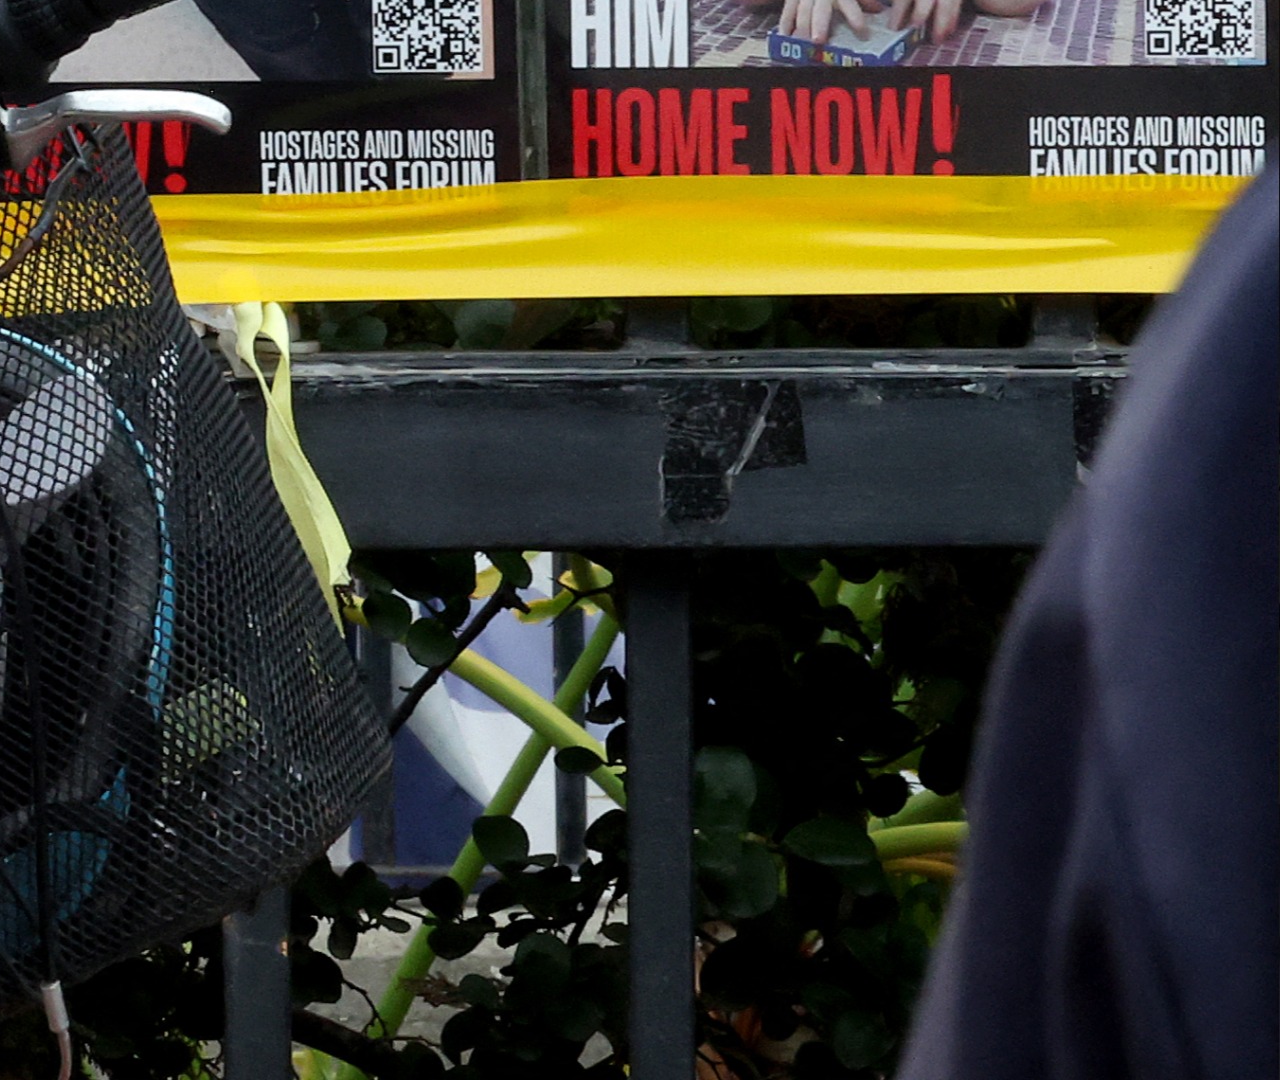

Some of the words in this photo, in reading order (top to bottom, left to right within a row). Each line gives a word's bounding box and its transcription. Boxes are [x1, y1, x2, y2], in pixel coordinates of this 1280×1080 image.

[571, 86, 751, 178] HOME
[770, 73, 961, 177] NOW!
[1029, 116, 1129, 147] HOSTAGES
[1133, 116, 1173, 147] AND
[1177, 115, 1266, 147] MISSING
[260, 130, 360, 160] HOSTAGES
[364, 129, 403, 159] AND
[407, 128, 495, 159] MISSING
[261, 160, 388, 196] FAMILIES
[395, 159, 496, 191] FORUM
[1030, 147, 1158, 177] FAMILIES
[1164, 148, 1267, 177] FORUM
